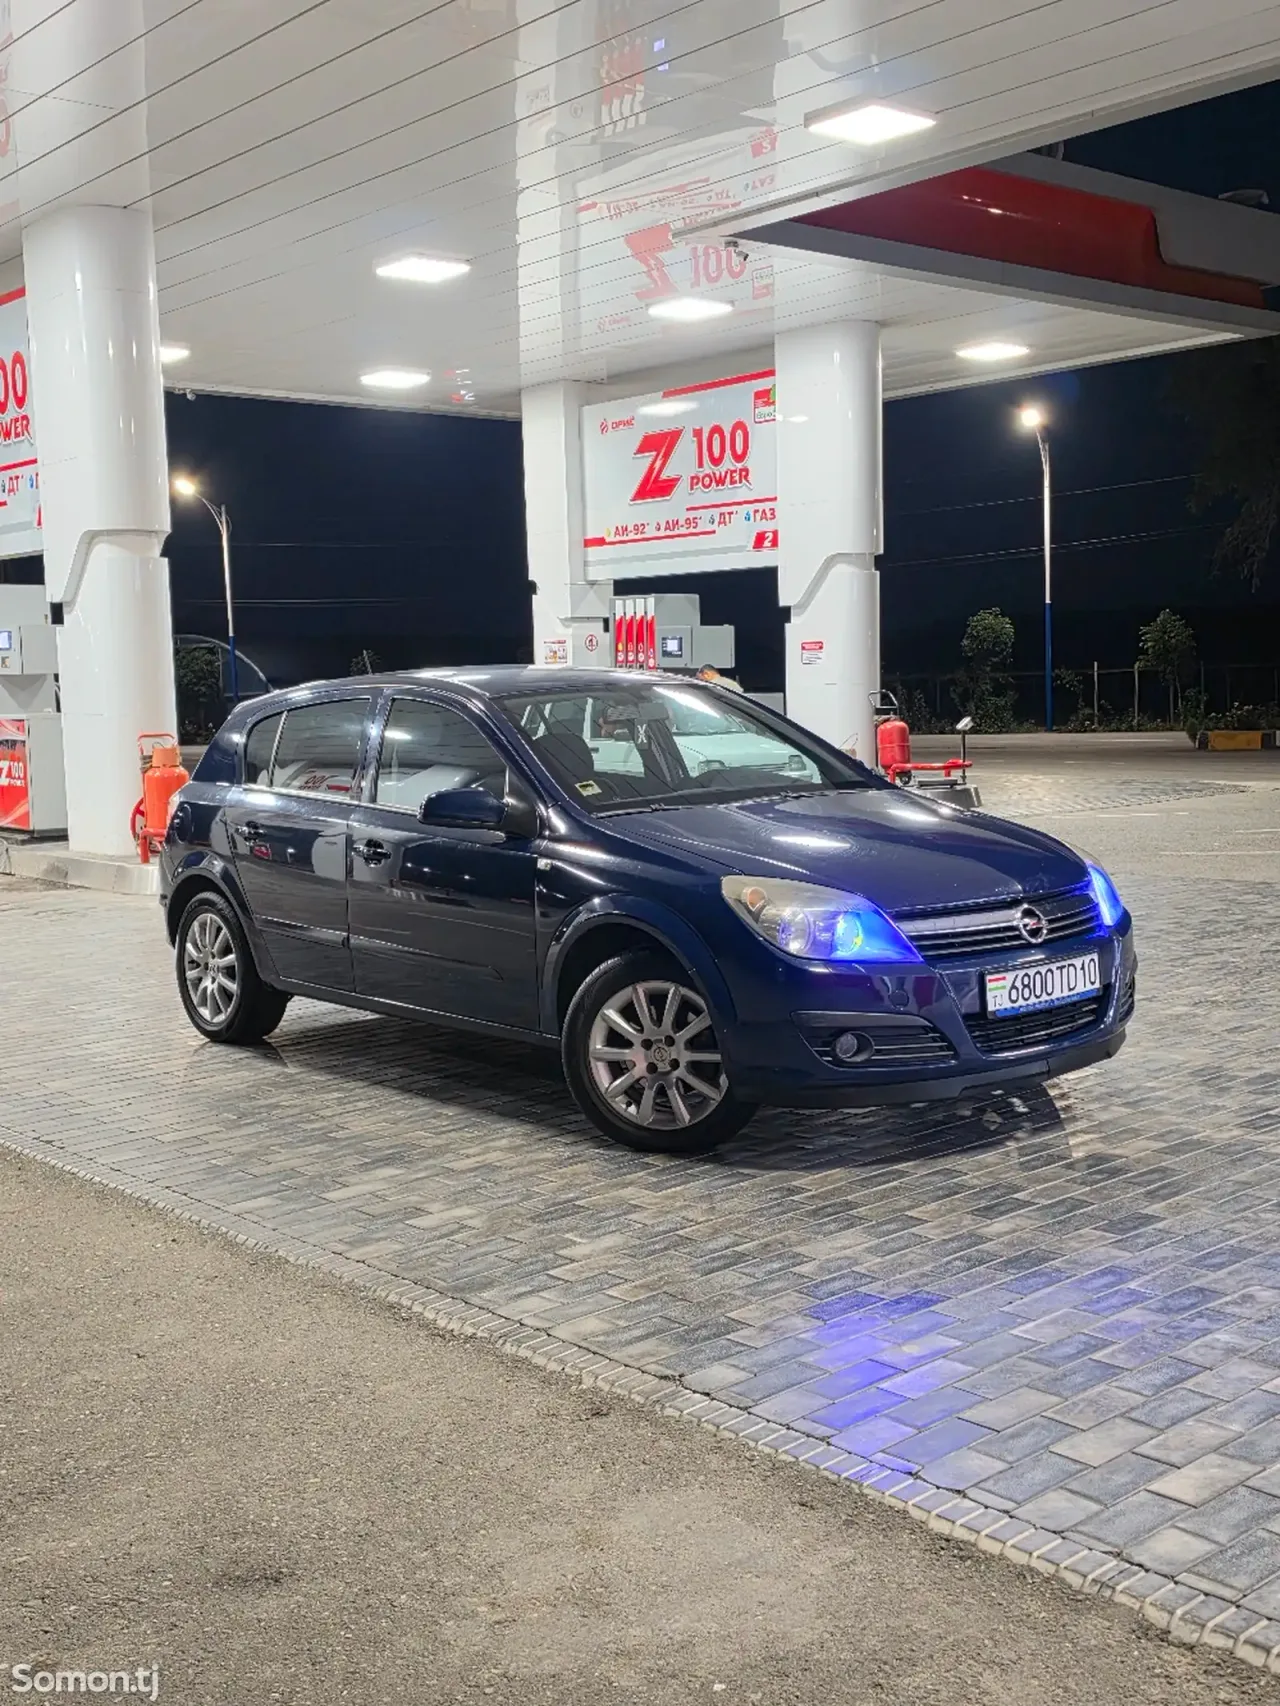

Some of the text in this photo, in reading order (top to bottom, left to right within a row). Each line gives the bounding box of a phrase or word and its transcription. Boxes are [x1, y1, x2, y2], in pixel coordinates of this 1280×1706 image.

[629, 420, 750, 504] Z 100
[689, 468, 752, 491] POWER
[753, 508, 776, 522] ГАЗ
[763, 532, 773, 547] 2
